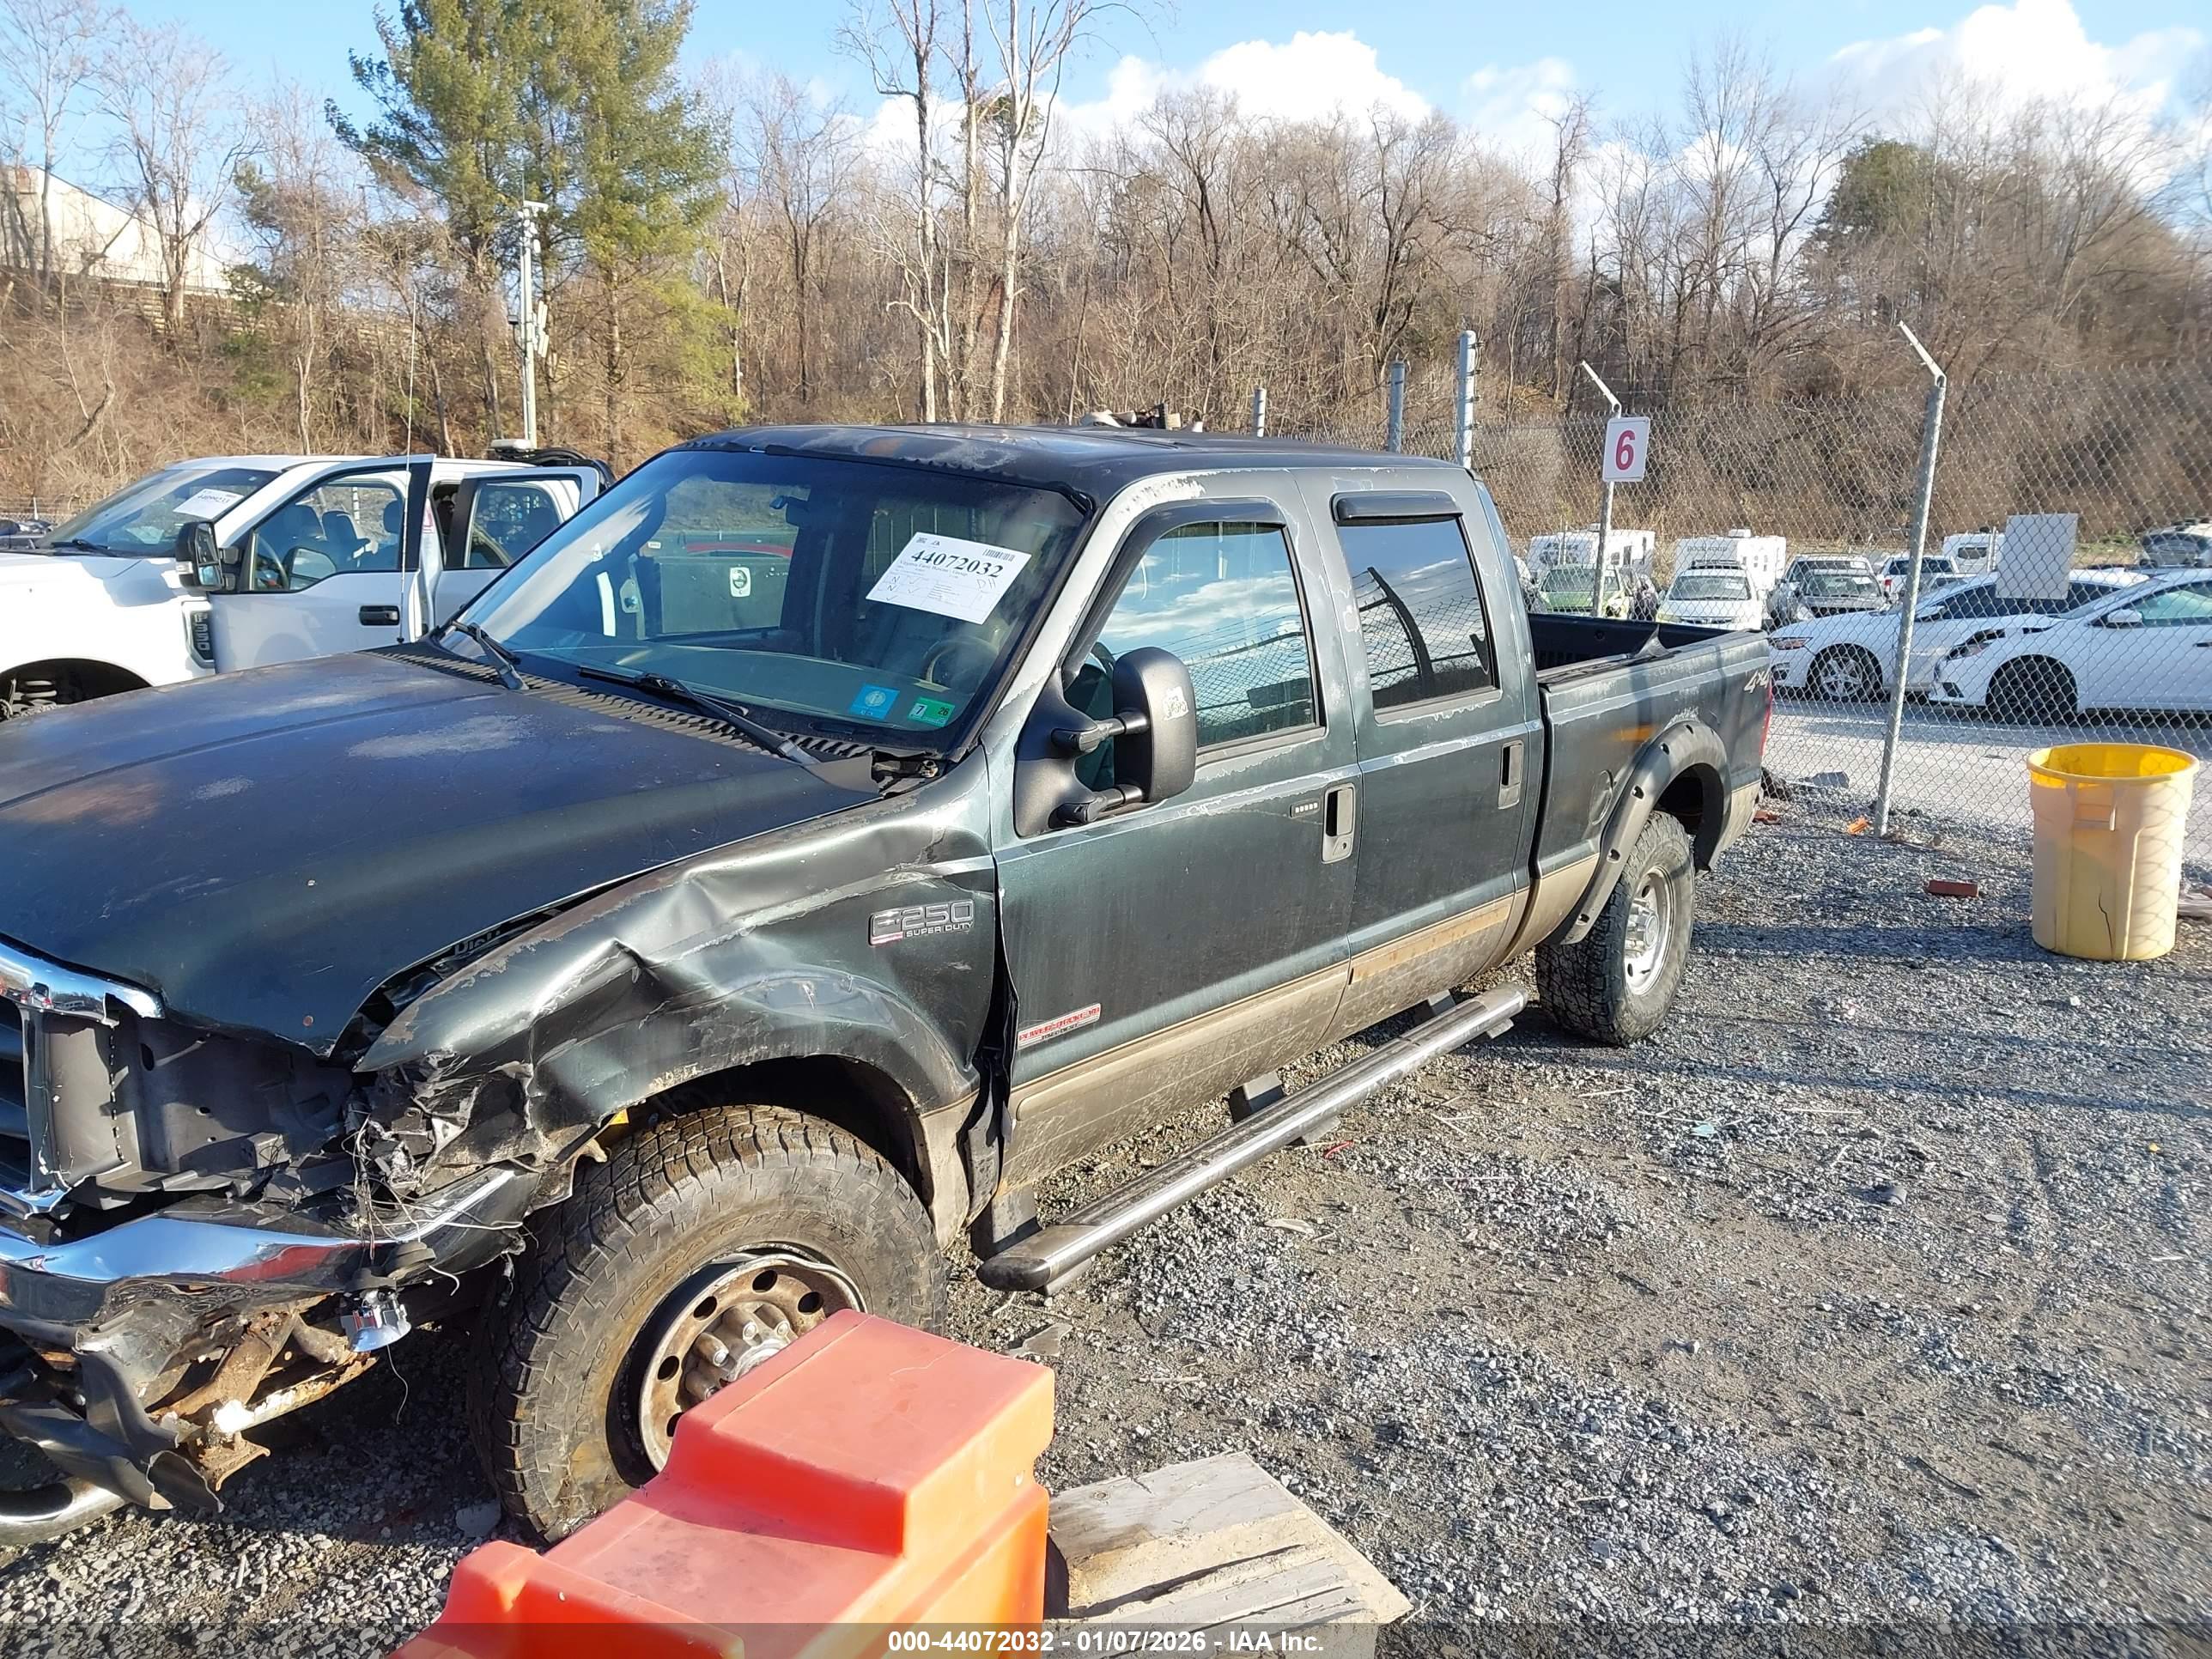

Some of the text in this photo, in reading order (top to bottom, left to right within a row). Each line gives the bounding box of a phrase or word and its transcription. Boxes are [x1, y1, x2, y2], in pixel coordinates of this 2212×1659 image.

[1616, 430, 1636, 471] 6
[911, 550, 1004, 579] 44072032
[915, 705, 950, 716] 7 26
[905, 921, 974, 938] SUPER DUTY
